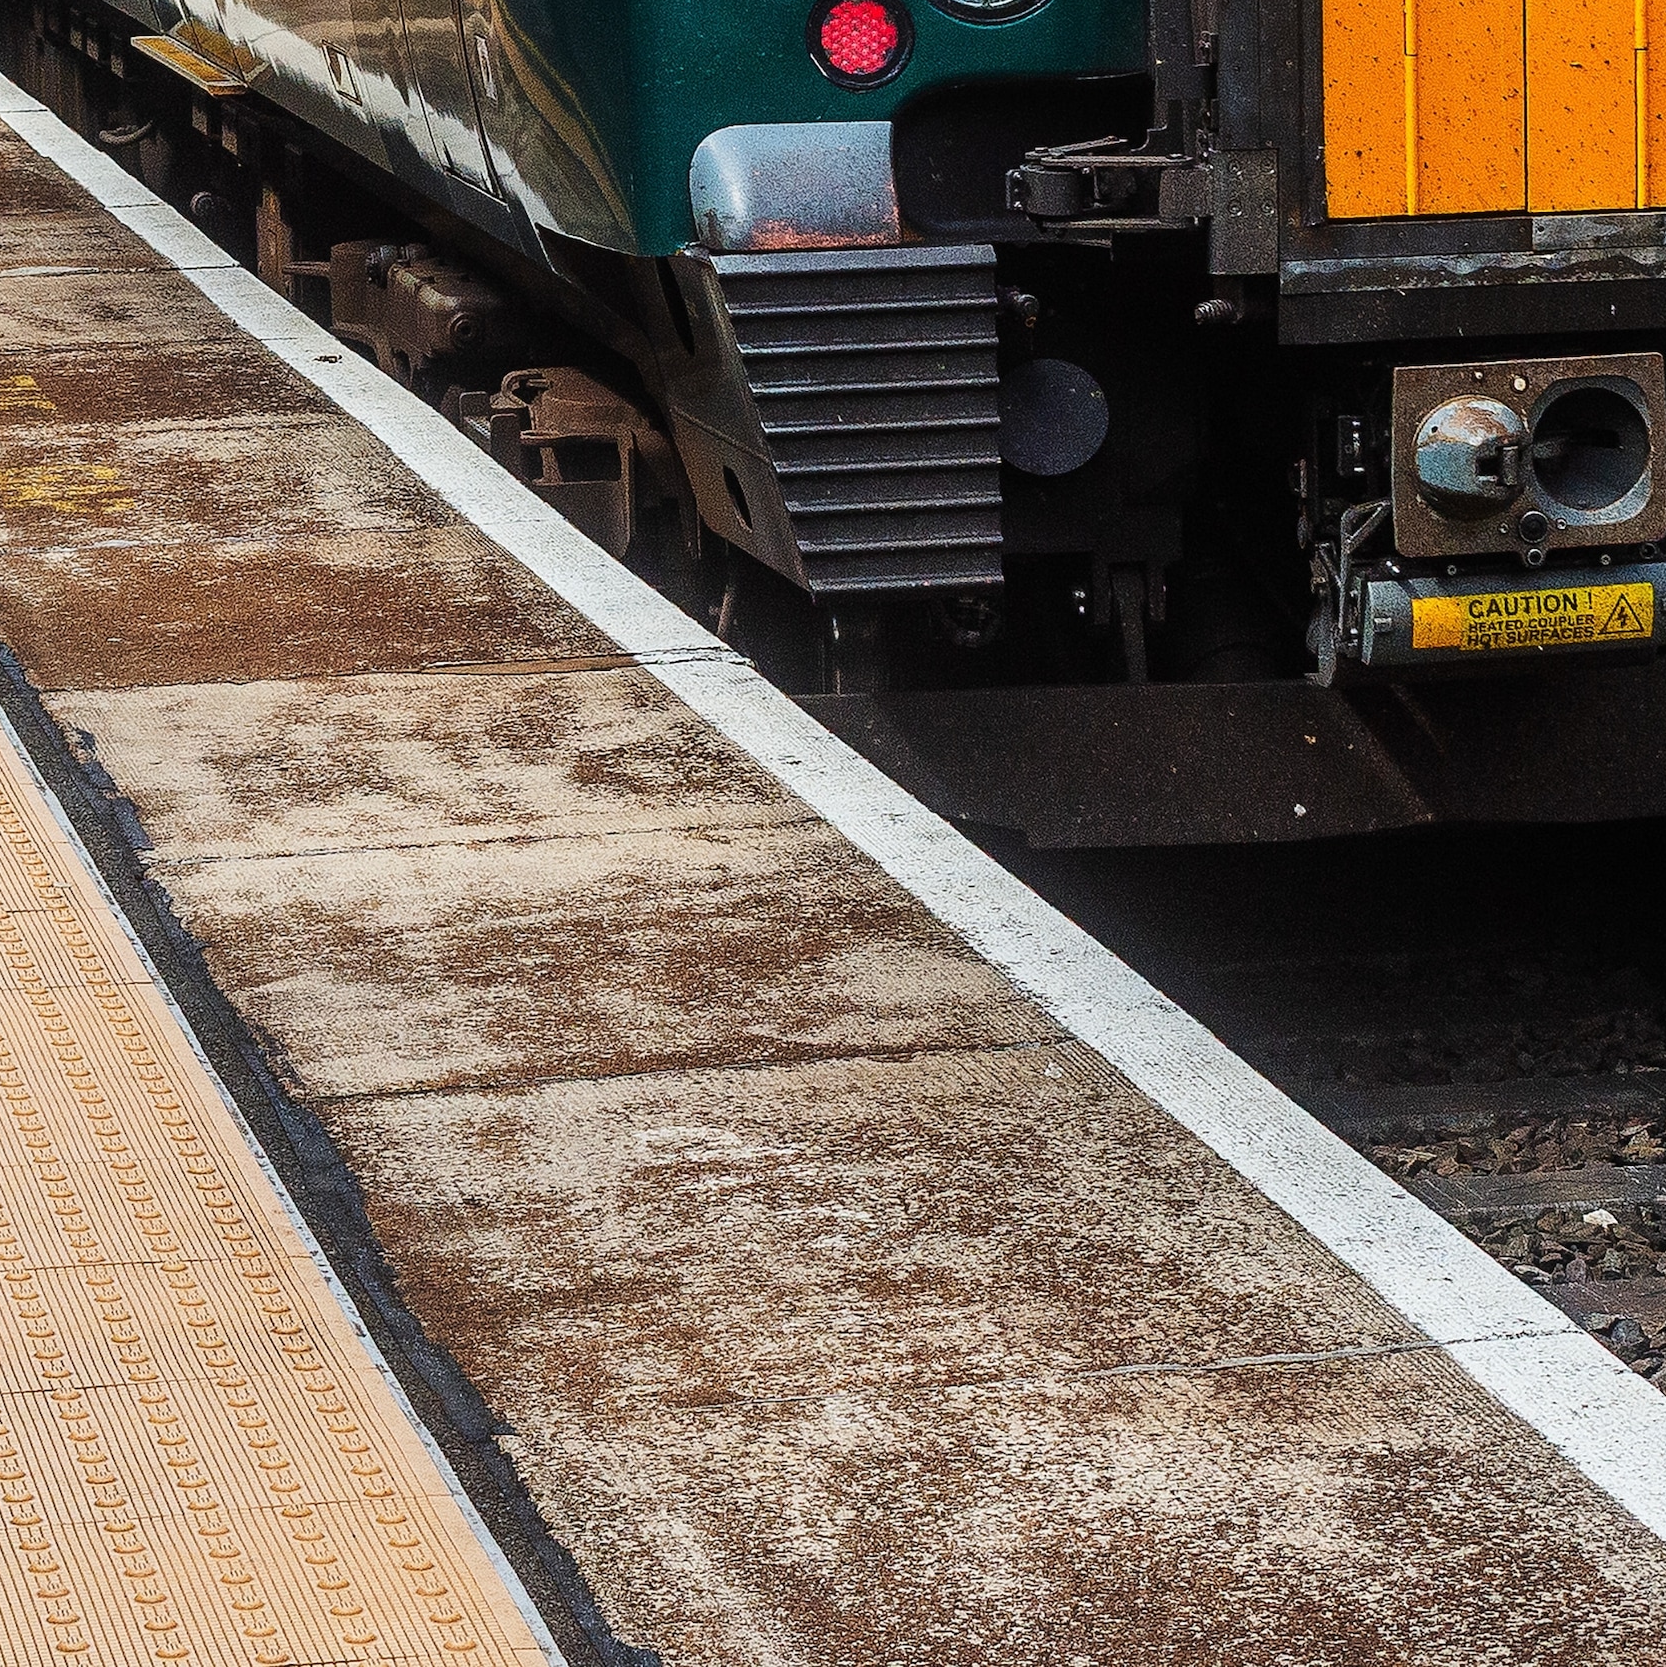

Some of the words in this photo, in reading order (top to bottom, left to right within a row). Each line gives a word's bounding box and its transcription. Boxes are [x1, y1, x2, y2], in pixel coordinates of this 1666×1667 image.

[1469, 593, 1577, 619] CAUTION
[1468, 619, 1525, 633] HEATED
[1527, 614, 1596, 630] COUPLER
[1467, 632, 1502, 646] HOT
[1506, 627, 1595, 645] SURFACES
